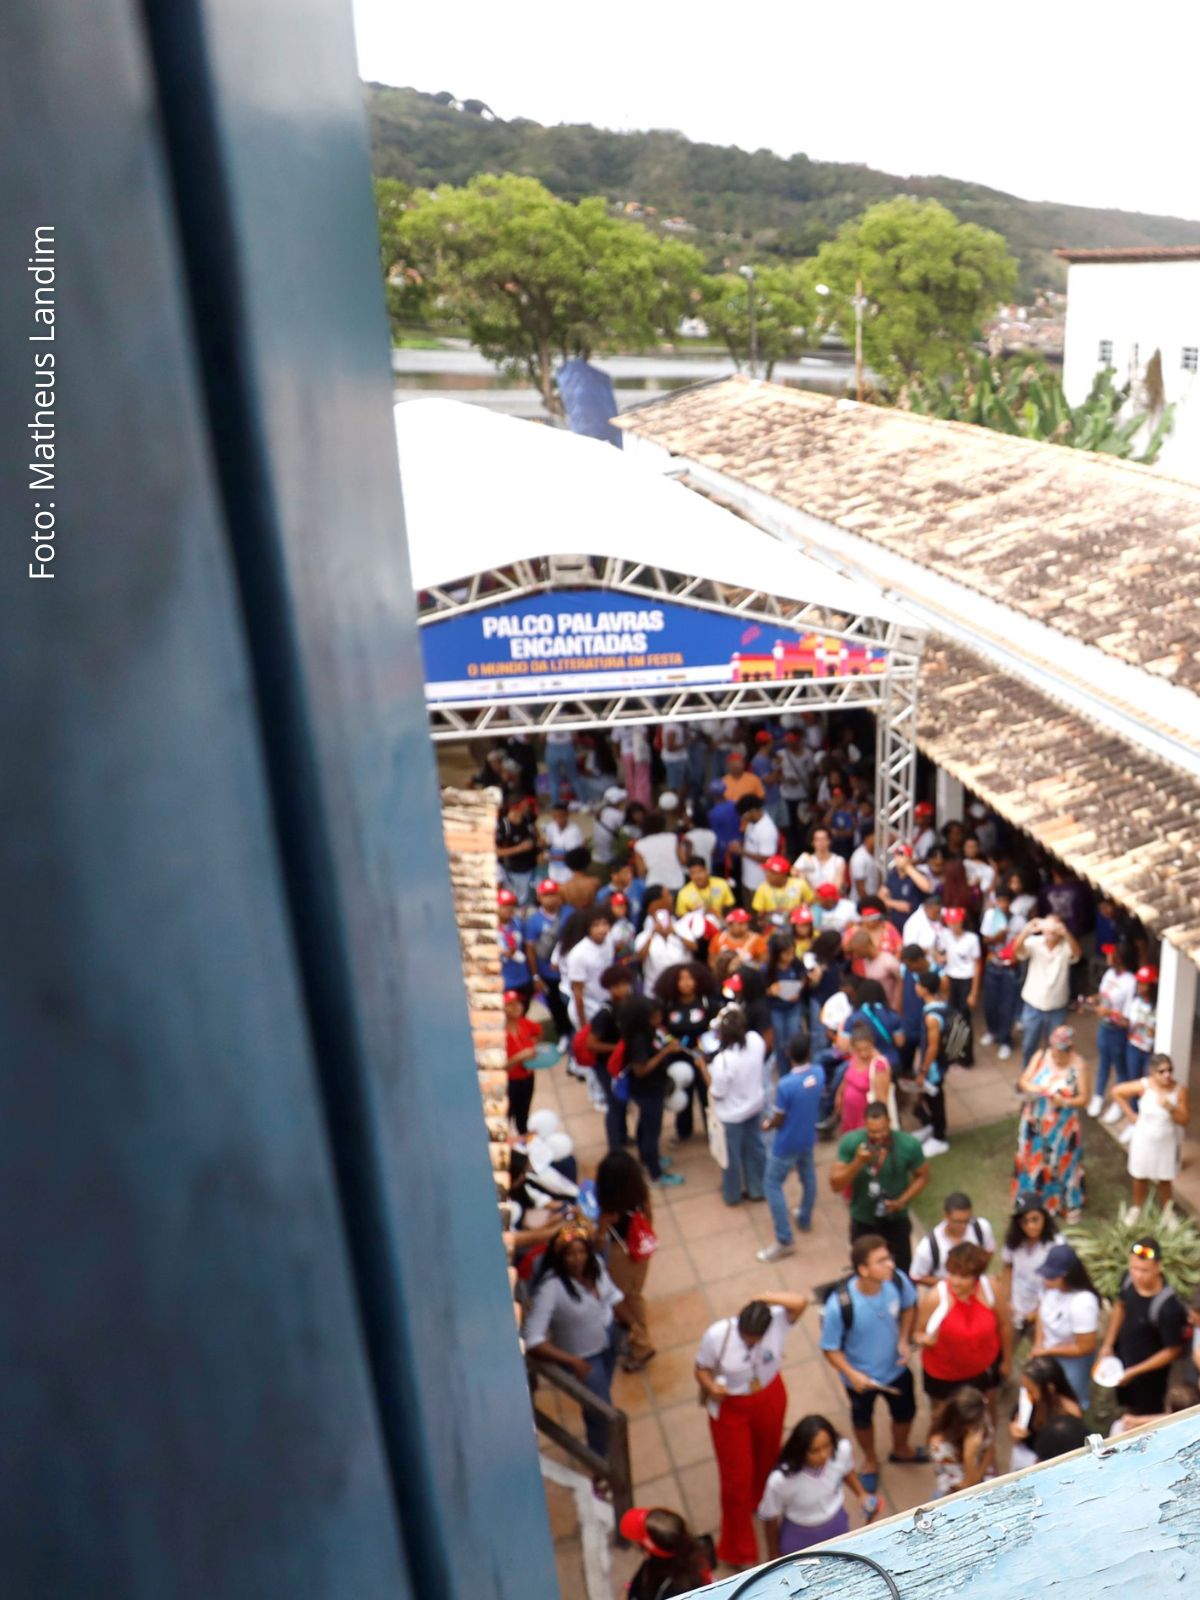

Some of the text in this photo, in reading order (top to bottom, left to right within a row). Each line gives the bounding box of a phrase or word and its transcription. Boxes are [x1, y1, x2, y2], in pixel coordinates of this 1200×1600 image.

[482, 610, 665, 639] PALCO PALAVRAS
[510, 632, 648, 660] ENCANTADAS
[530, 658, 548, 673] DA
[647, 652, 683, 667] FESTA
